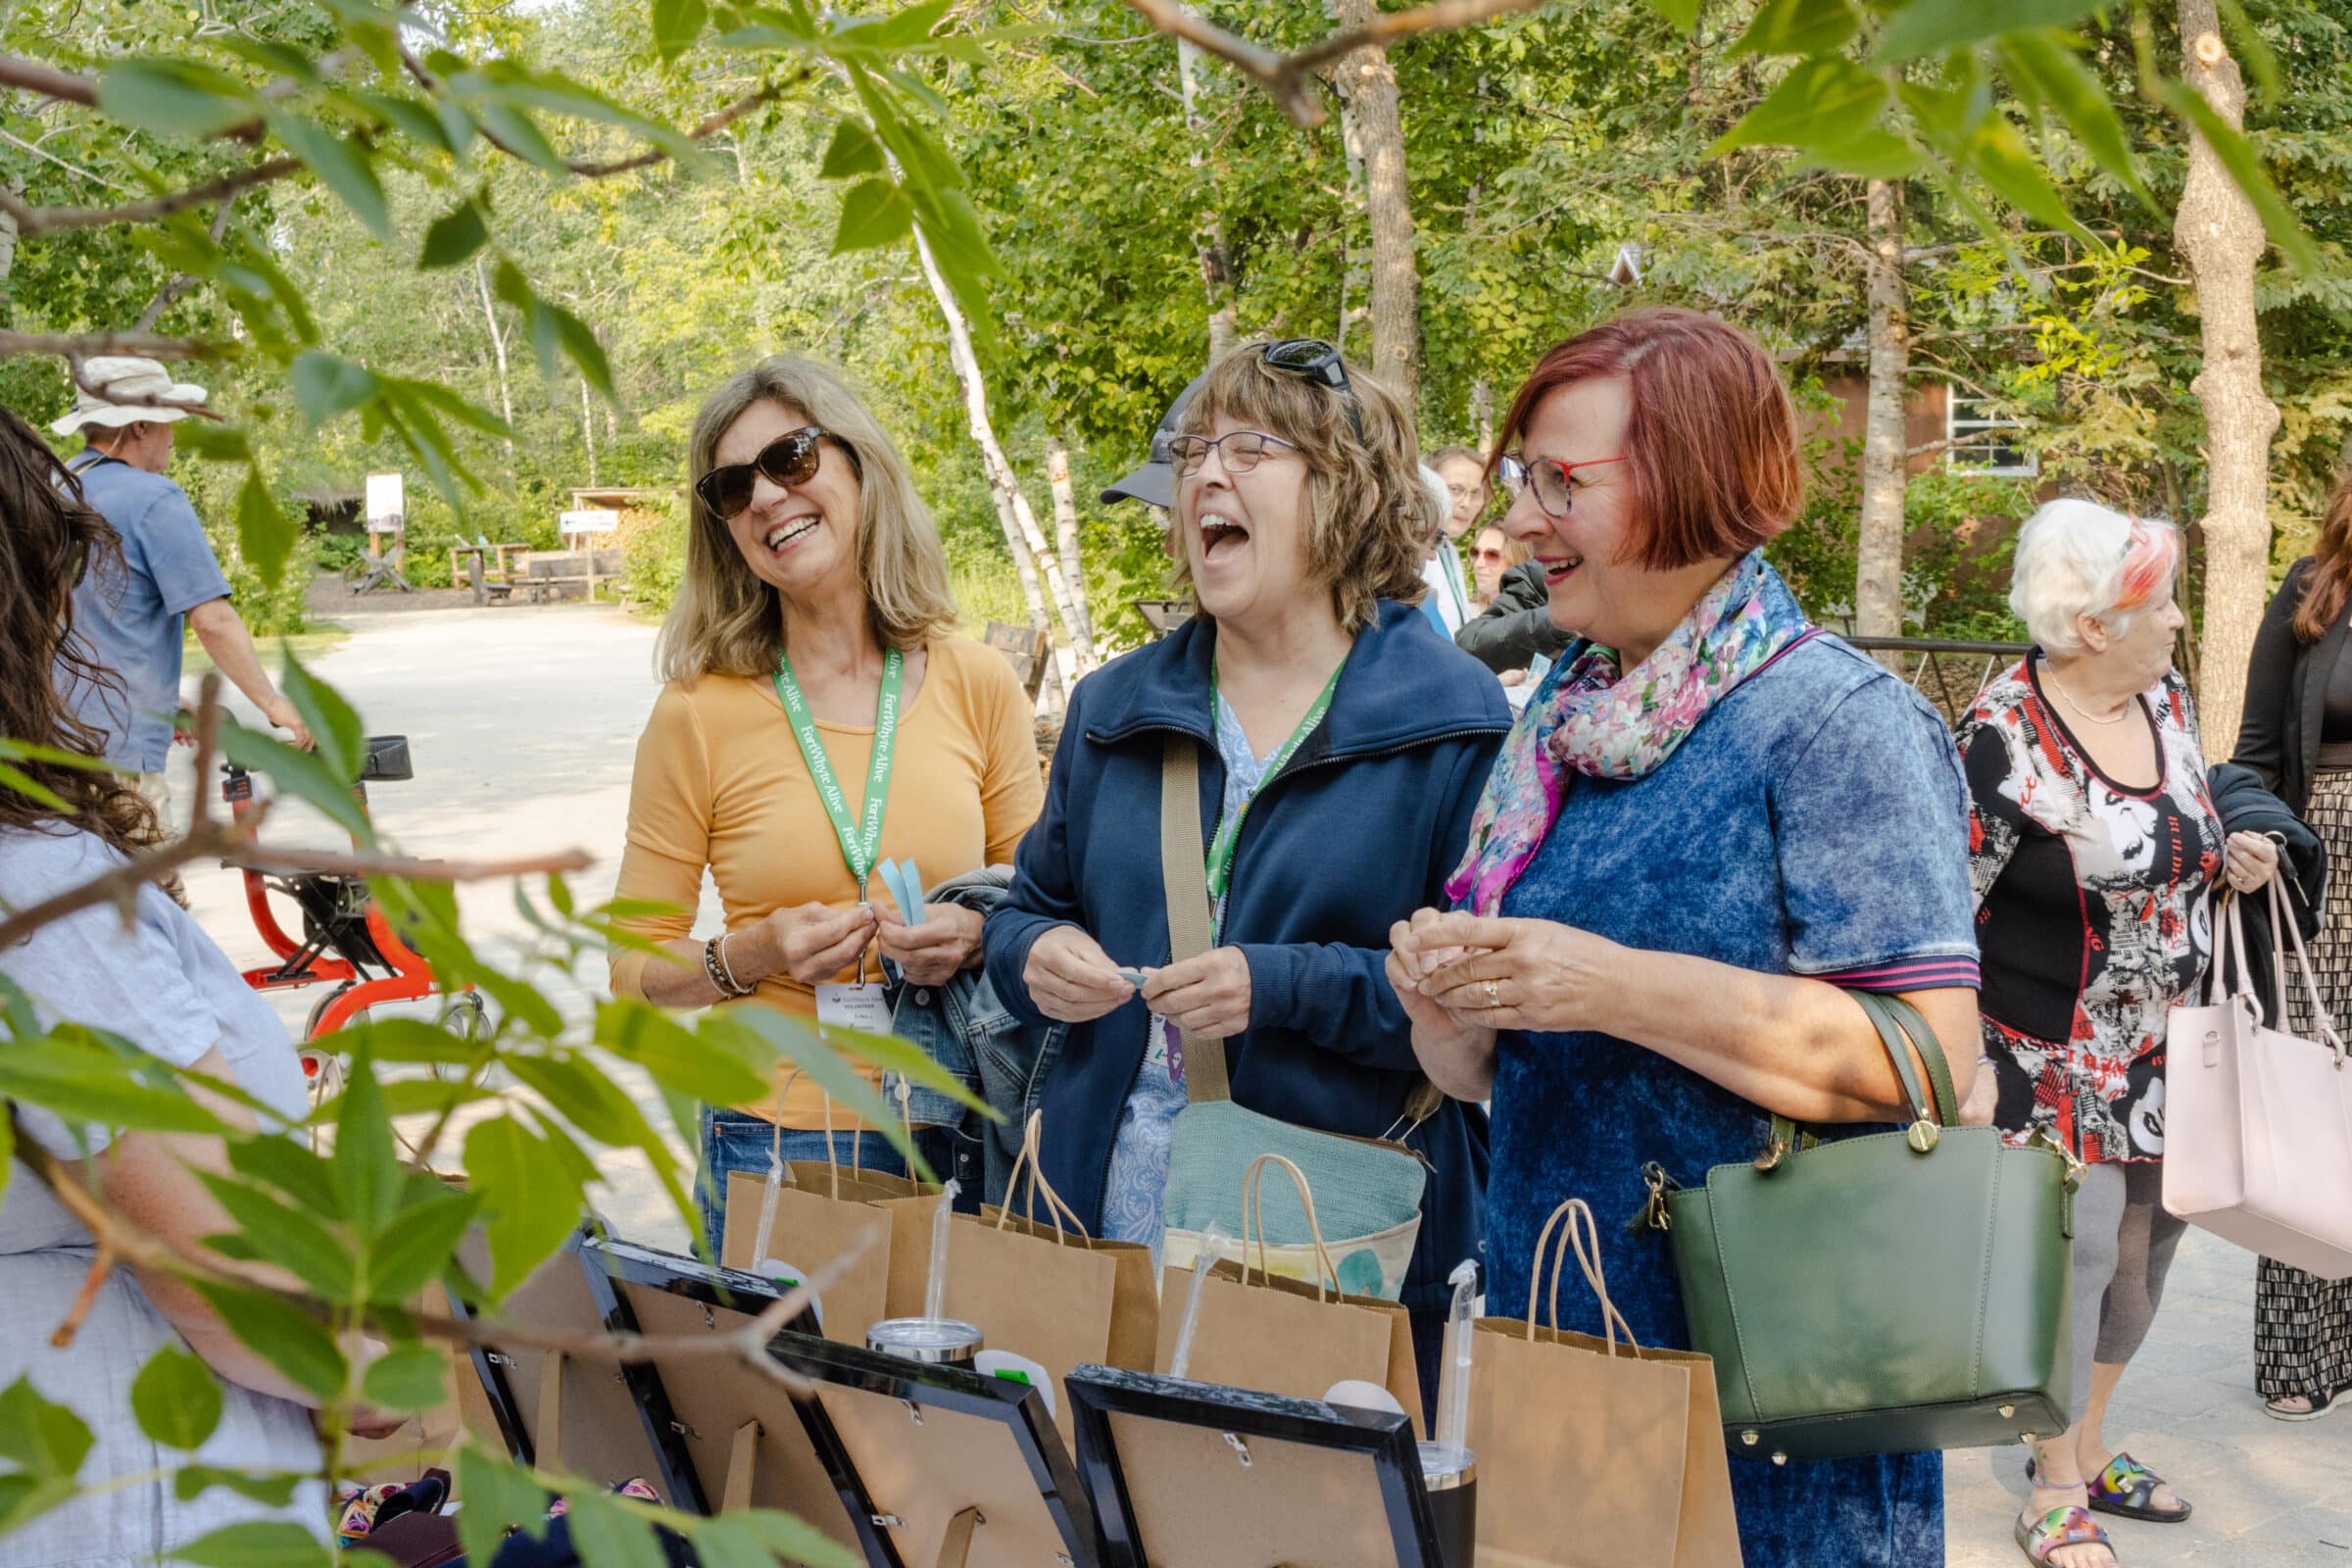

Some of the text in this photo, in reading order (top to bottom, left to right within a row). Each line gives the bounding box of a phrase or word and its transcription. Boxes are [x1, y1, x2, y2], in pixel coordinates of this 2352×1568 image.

[784, 685, 802, 712] Alive
[873, 692, 896, 783] FortWhyte Alive
[801, 725, 843, 812] FortWhyte Alive
